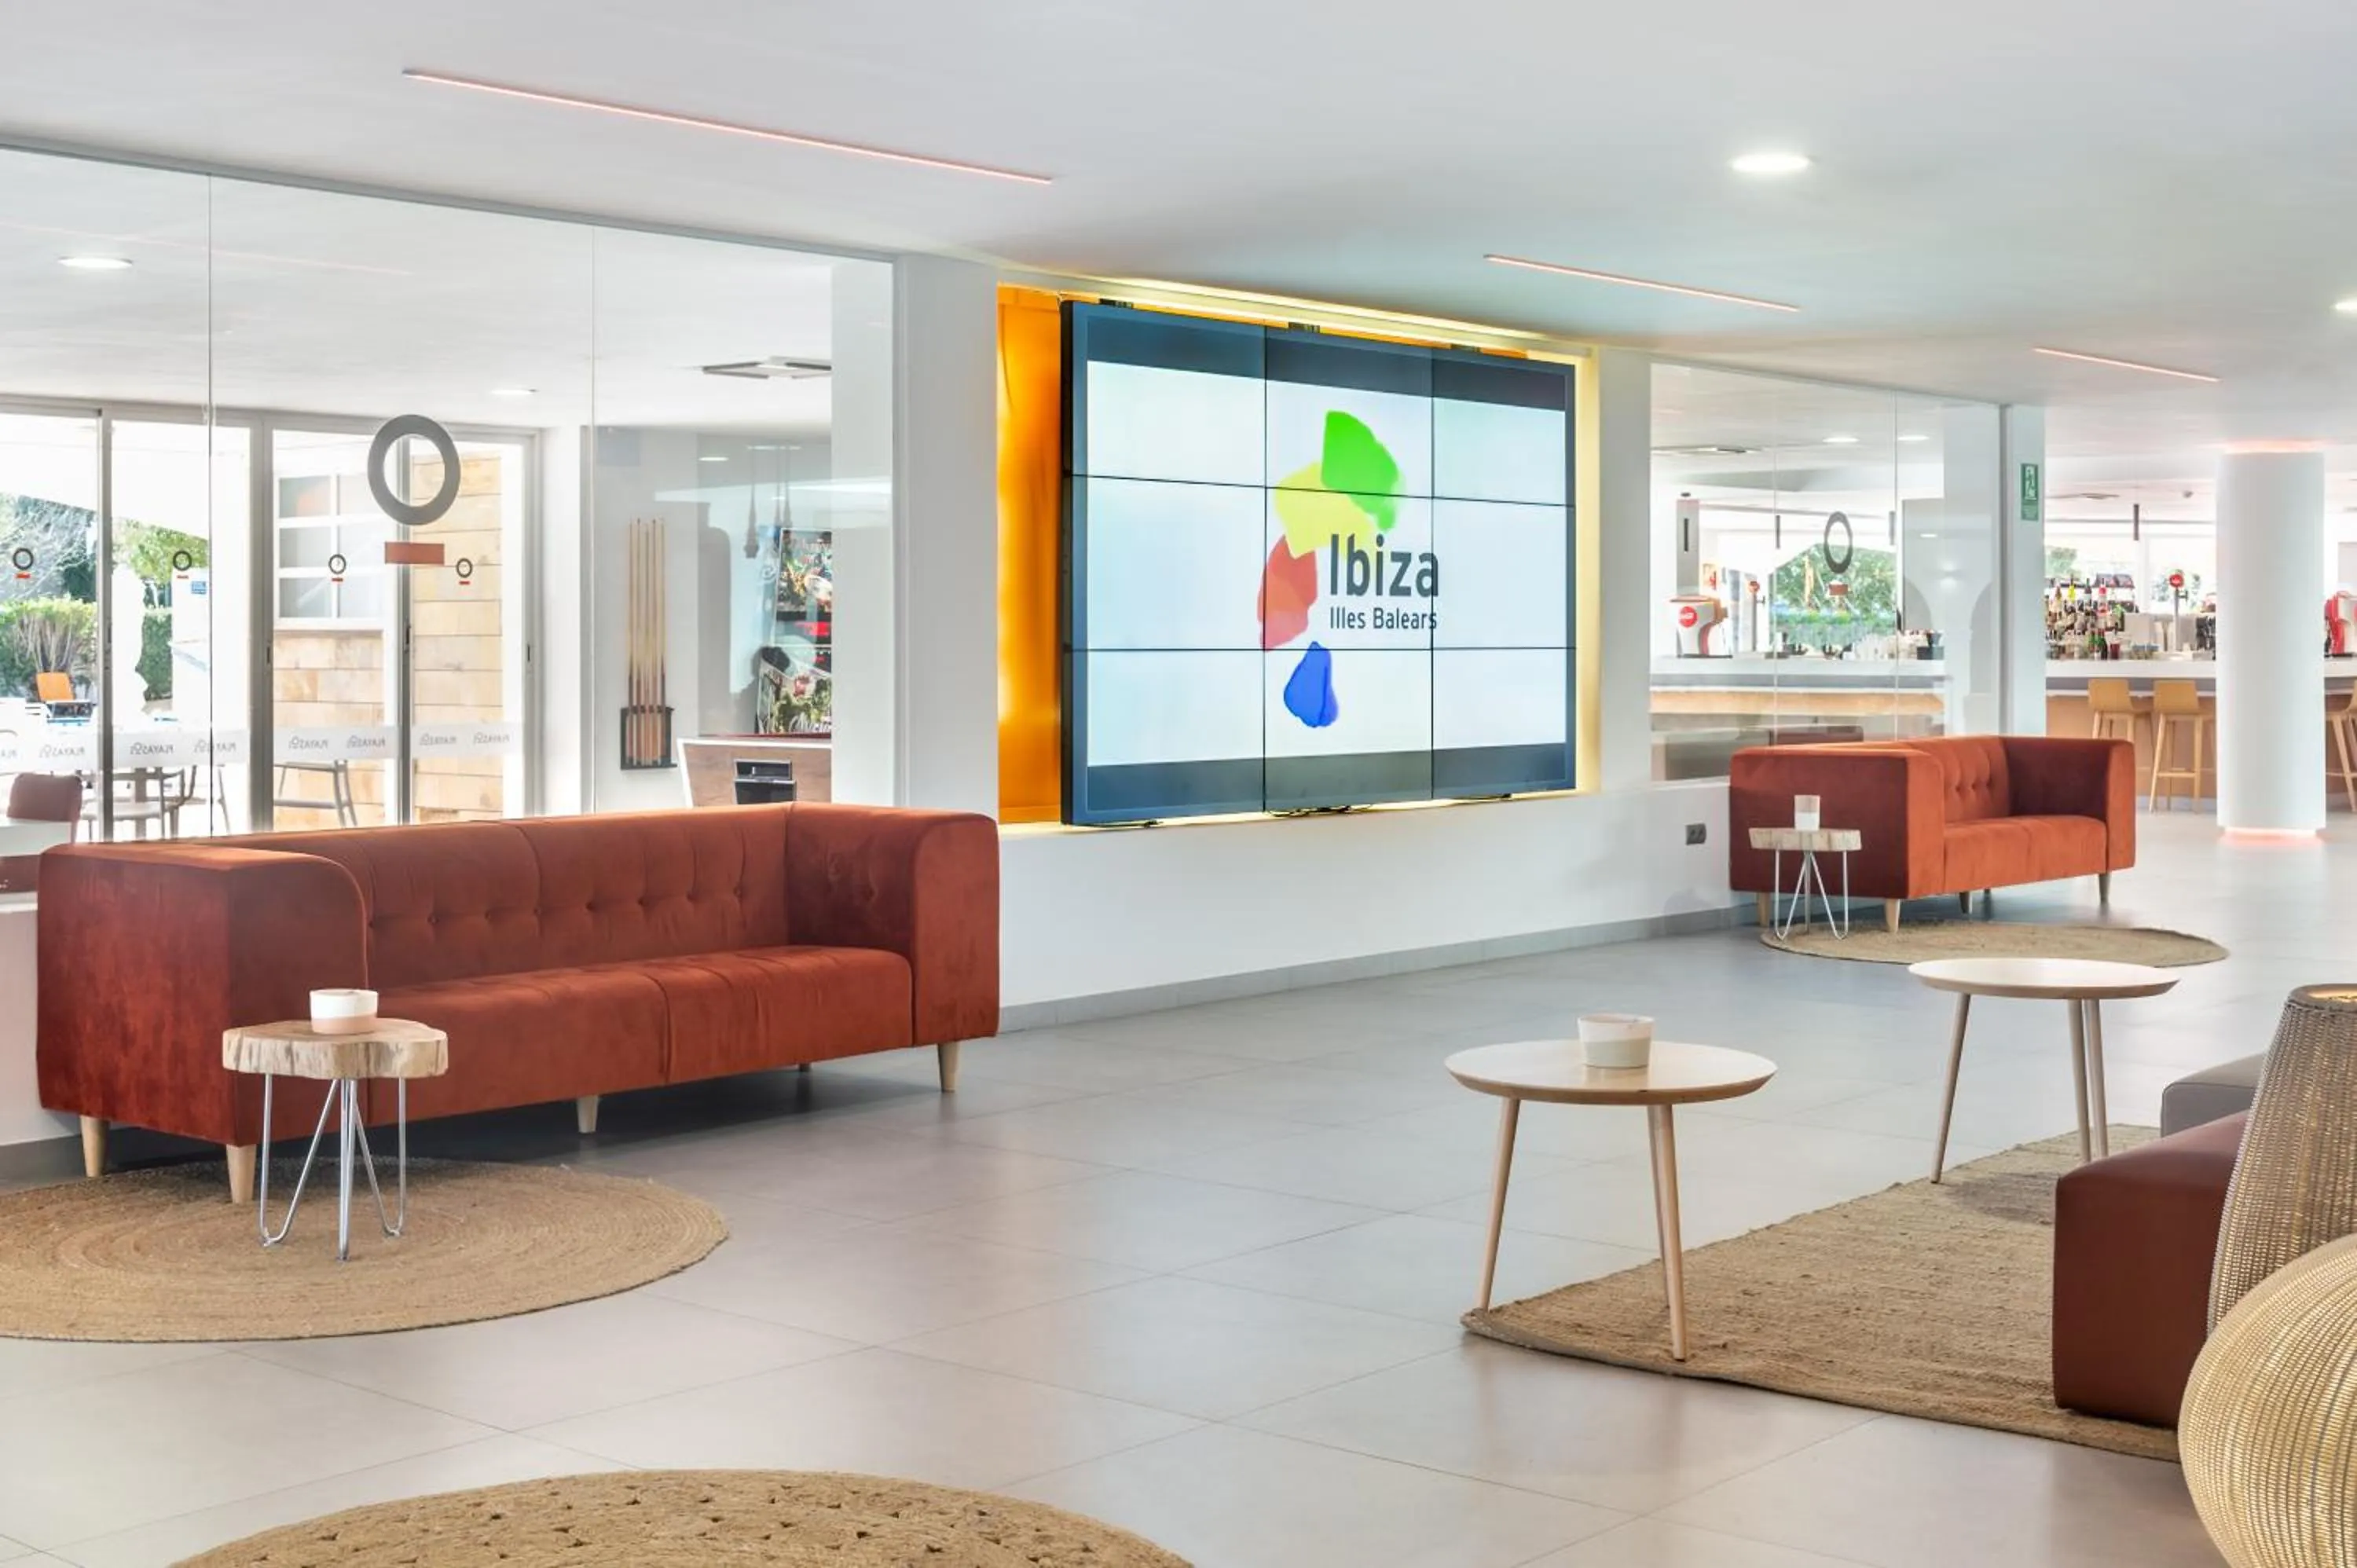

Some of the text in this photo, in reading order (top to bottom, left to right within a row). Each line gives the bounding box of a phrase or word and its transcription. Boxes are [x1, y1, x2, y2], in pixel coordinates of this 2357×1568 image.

[1330, 533, 1439, 598] Ibiza
[1330, 606, 1438, 629] Illes Balears
